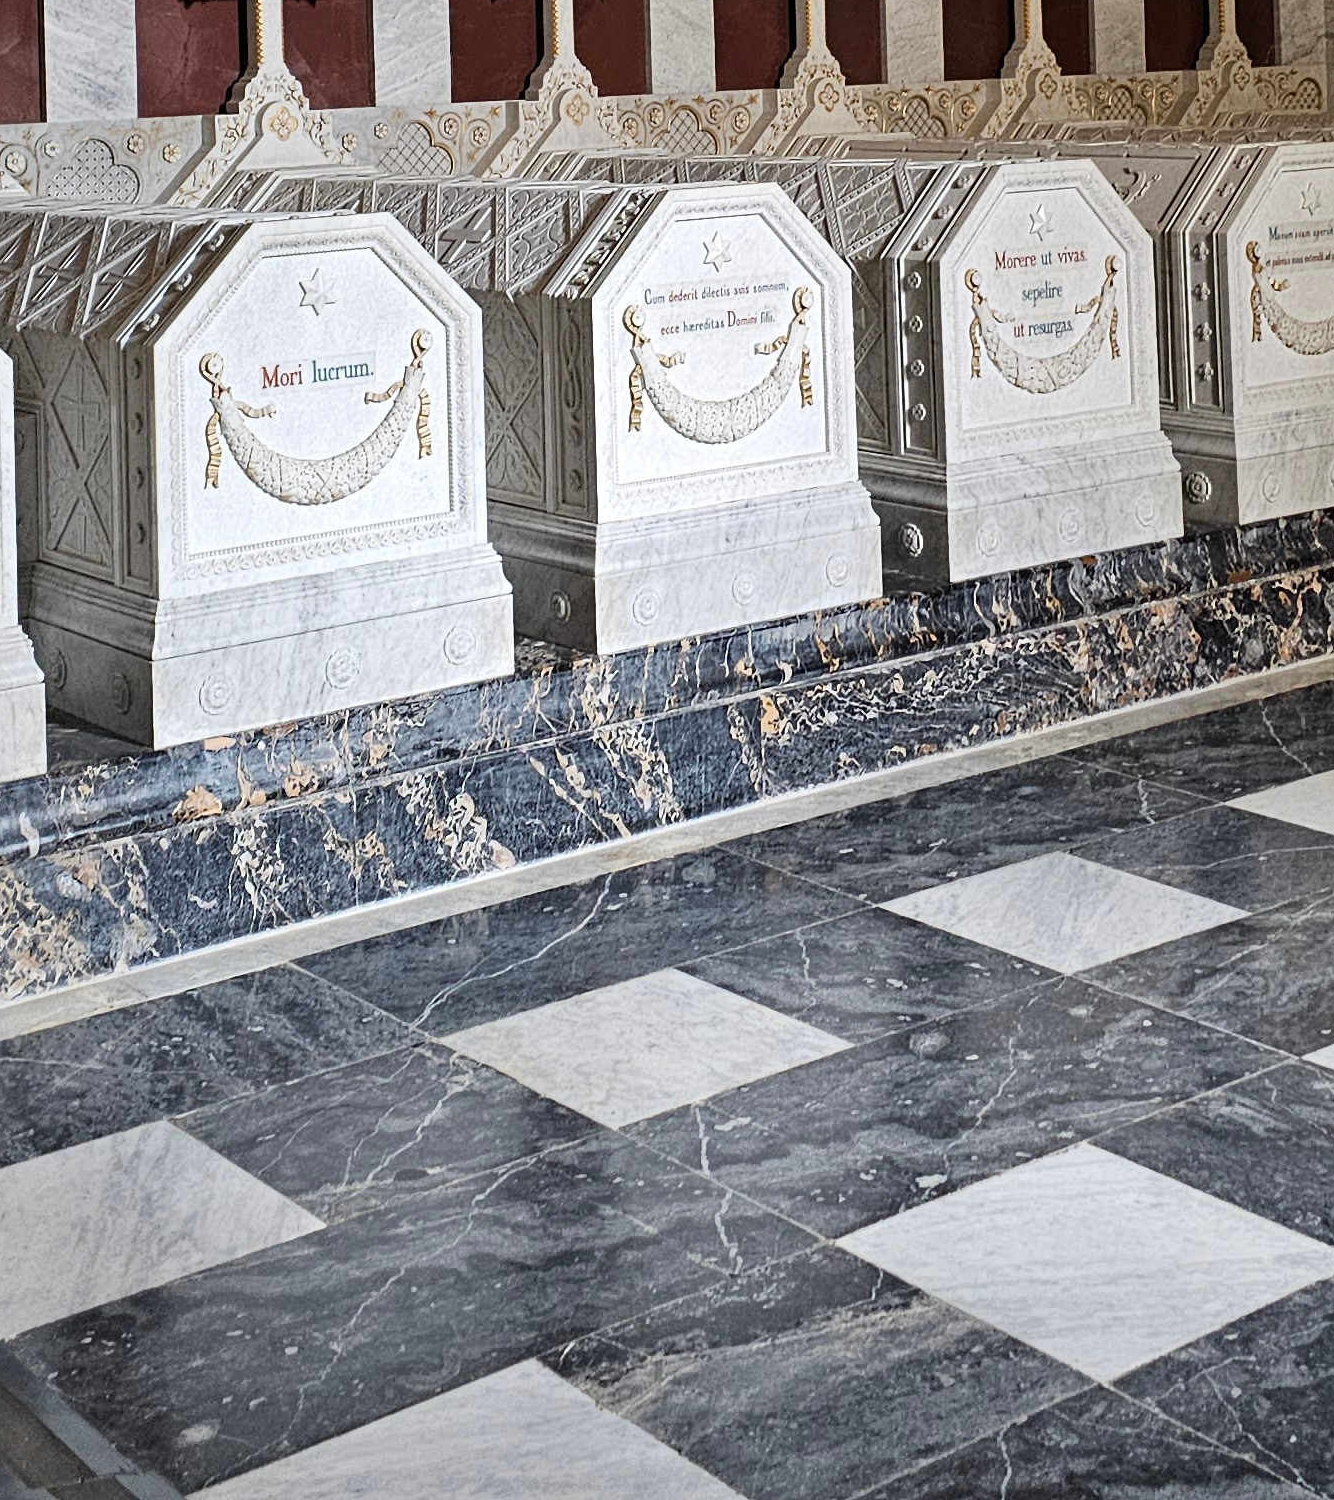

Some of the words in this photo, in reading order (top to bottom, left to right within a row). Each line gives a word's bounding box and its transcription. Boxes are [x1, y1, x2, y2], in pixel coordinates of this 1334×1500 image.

[994, 250, 1037, 271] Morere
[1041, 250, 1053, 266] ut
[643, 288, 666, 306] Cum
[668, 289, 700, 303] dederit
[1021, 279, 1063, 307] sepelire
[660, 325, 680, 336] ecce
[1013, 322, 1025, 338] ut
[260, 363, 304, 390] Mori
[311, 359, 375, 384] lucrum.
